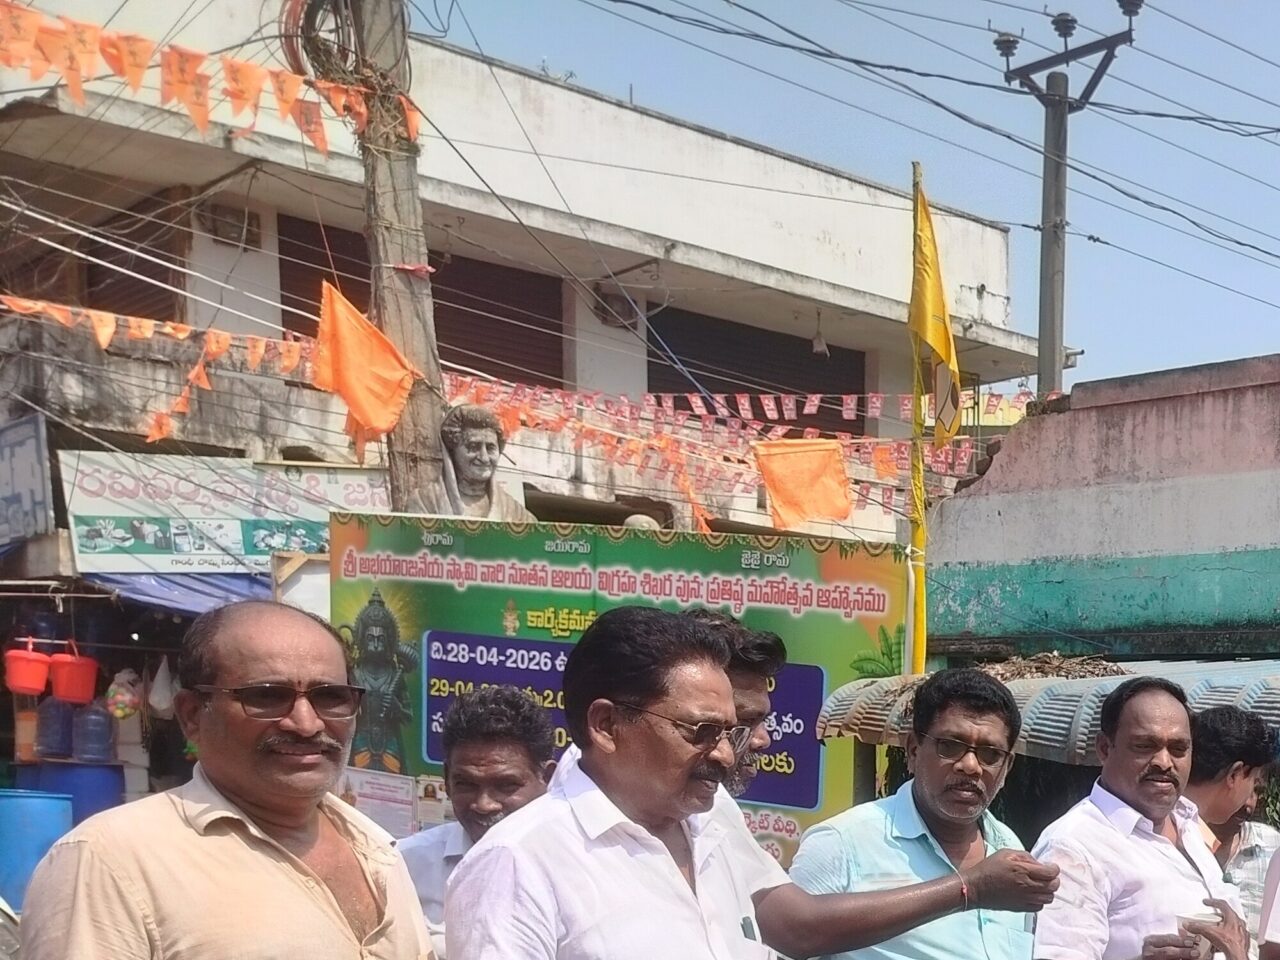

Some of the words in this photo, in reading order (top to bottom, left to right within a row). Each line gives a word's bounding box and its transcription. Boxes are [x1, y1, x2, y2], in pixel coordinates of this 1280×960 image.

[344, 549, 357, 579] శ్రీ
[359, 552, 444, 580] అభయాంజనేయ
[447, 557, 477, 588] స్వామి
[481, 561, 506, 583] వారి
[508, 562, 549, 588] నూతన
[551, 567, 592, 590] ఆలయ
[598, 570, 637, 597] విగ్రహ
[641, 573, 673, 602] శిఖర
[431, 641, 552, 672] ది.28-04-2026
